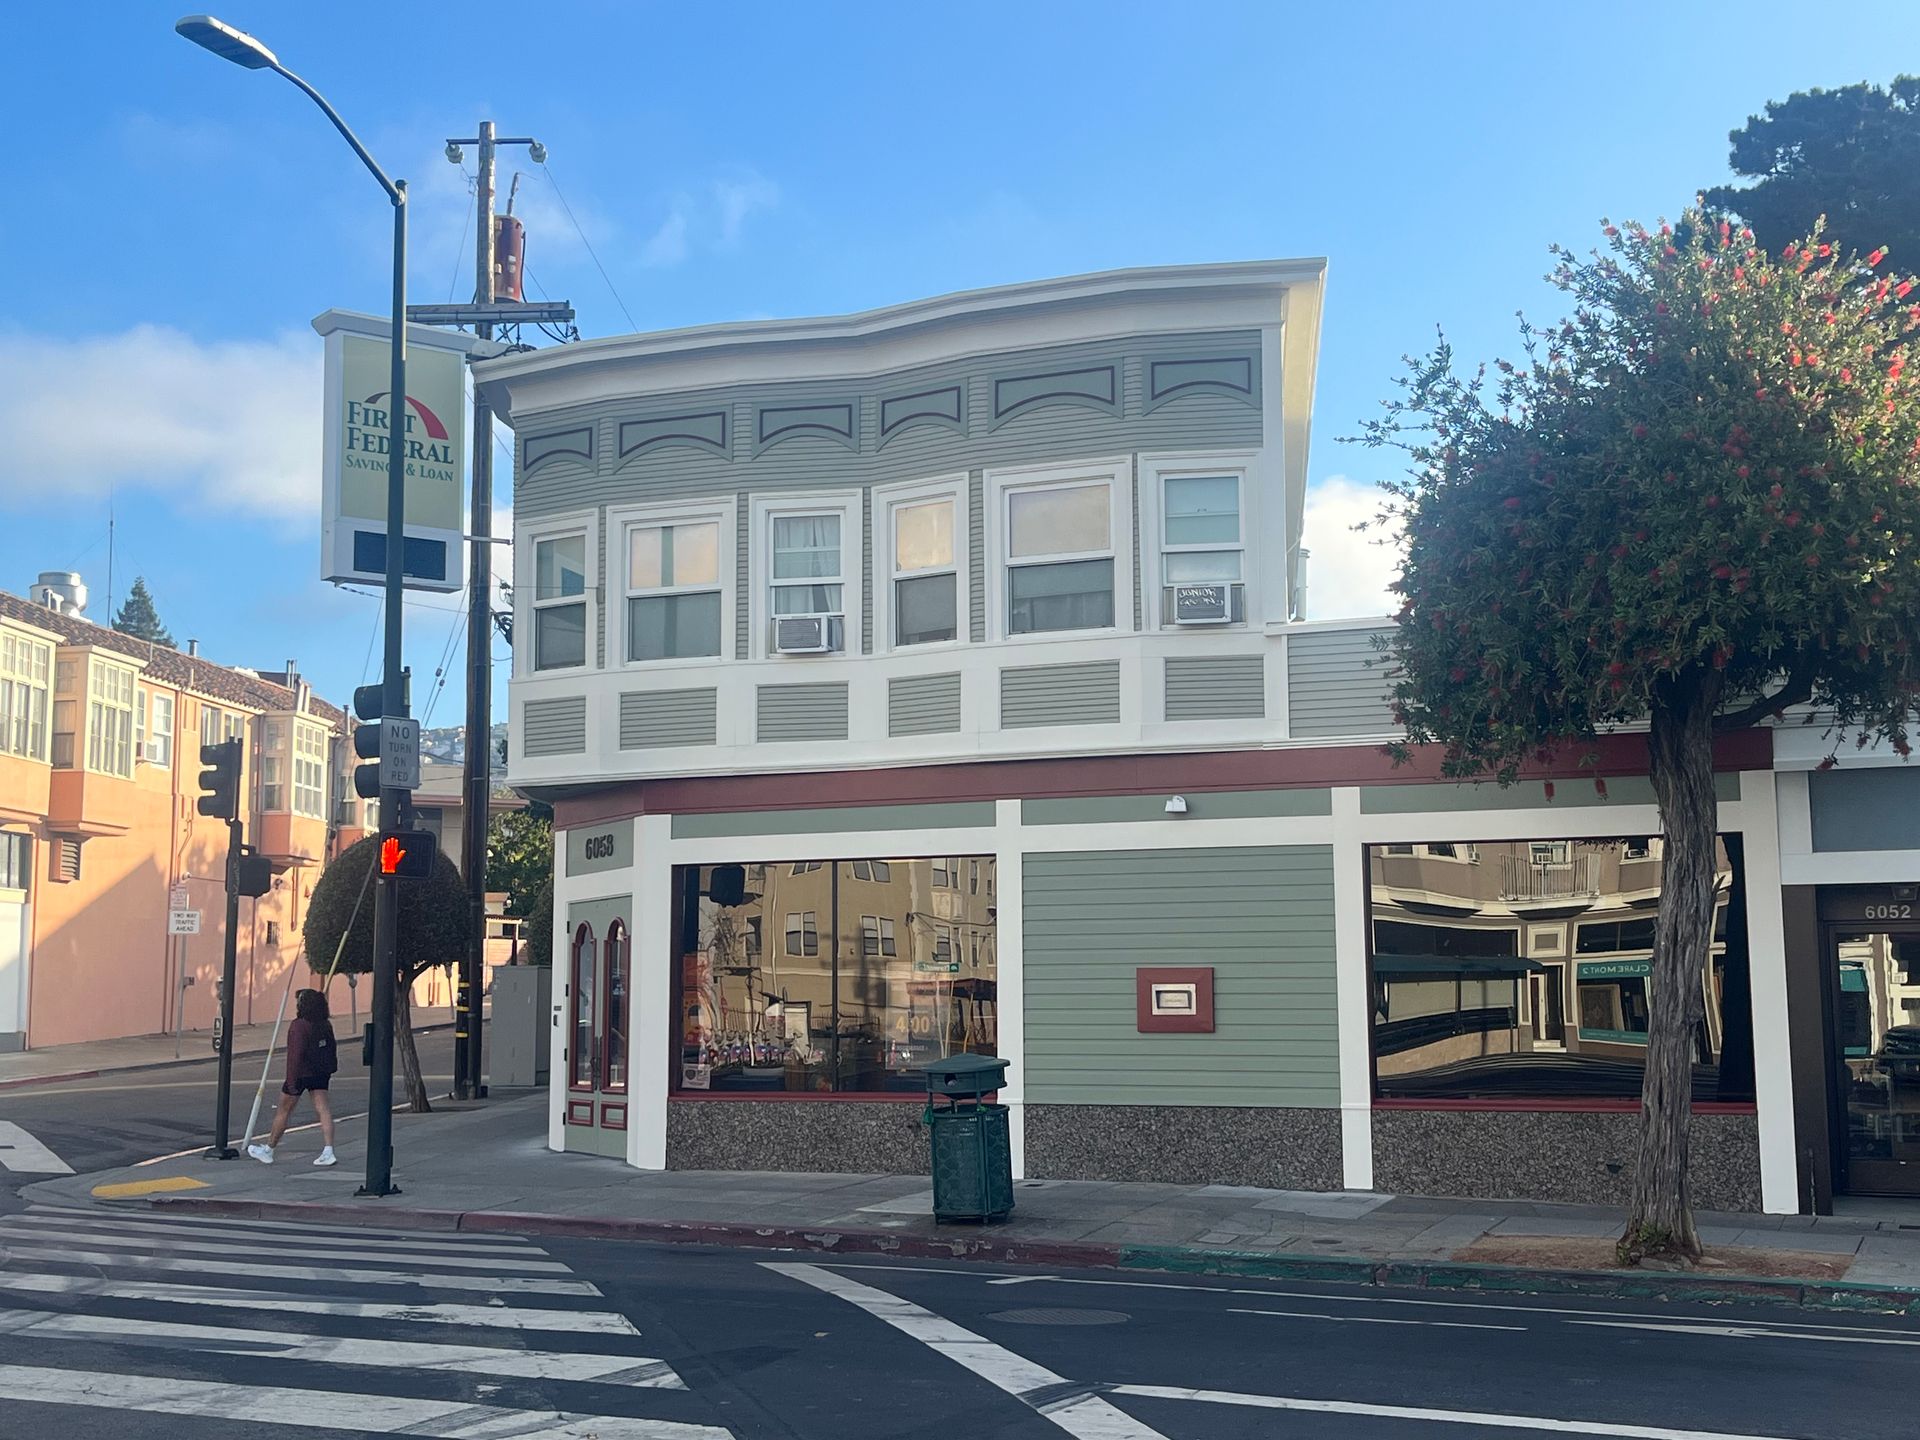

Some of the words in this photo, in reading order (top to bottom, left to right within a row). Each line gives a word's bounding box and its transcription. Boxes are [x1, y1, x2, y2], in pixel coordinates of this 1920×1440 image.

[347, 401, 417, 433] FIRT
[346, 454, 391, 472] SAVIN
[405, 463, 416, 476] &
[420, 465, 453, 481] LOAN
[391, 725, 410, 739] NO
[388, 742, 412, 754] TURN
[393, 756, 406, 767] ON
[391, 771, 409, 782] RED
[585, 834, 614, 860] 6058
[1865, 905, 1911, 919] 6052
